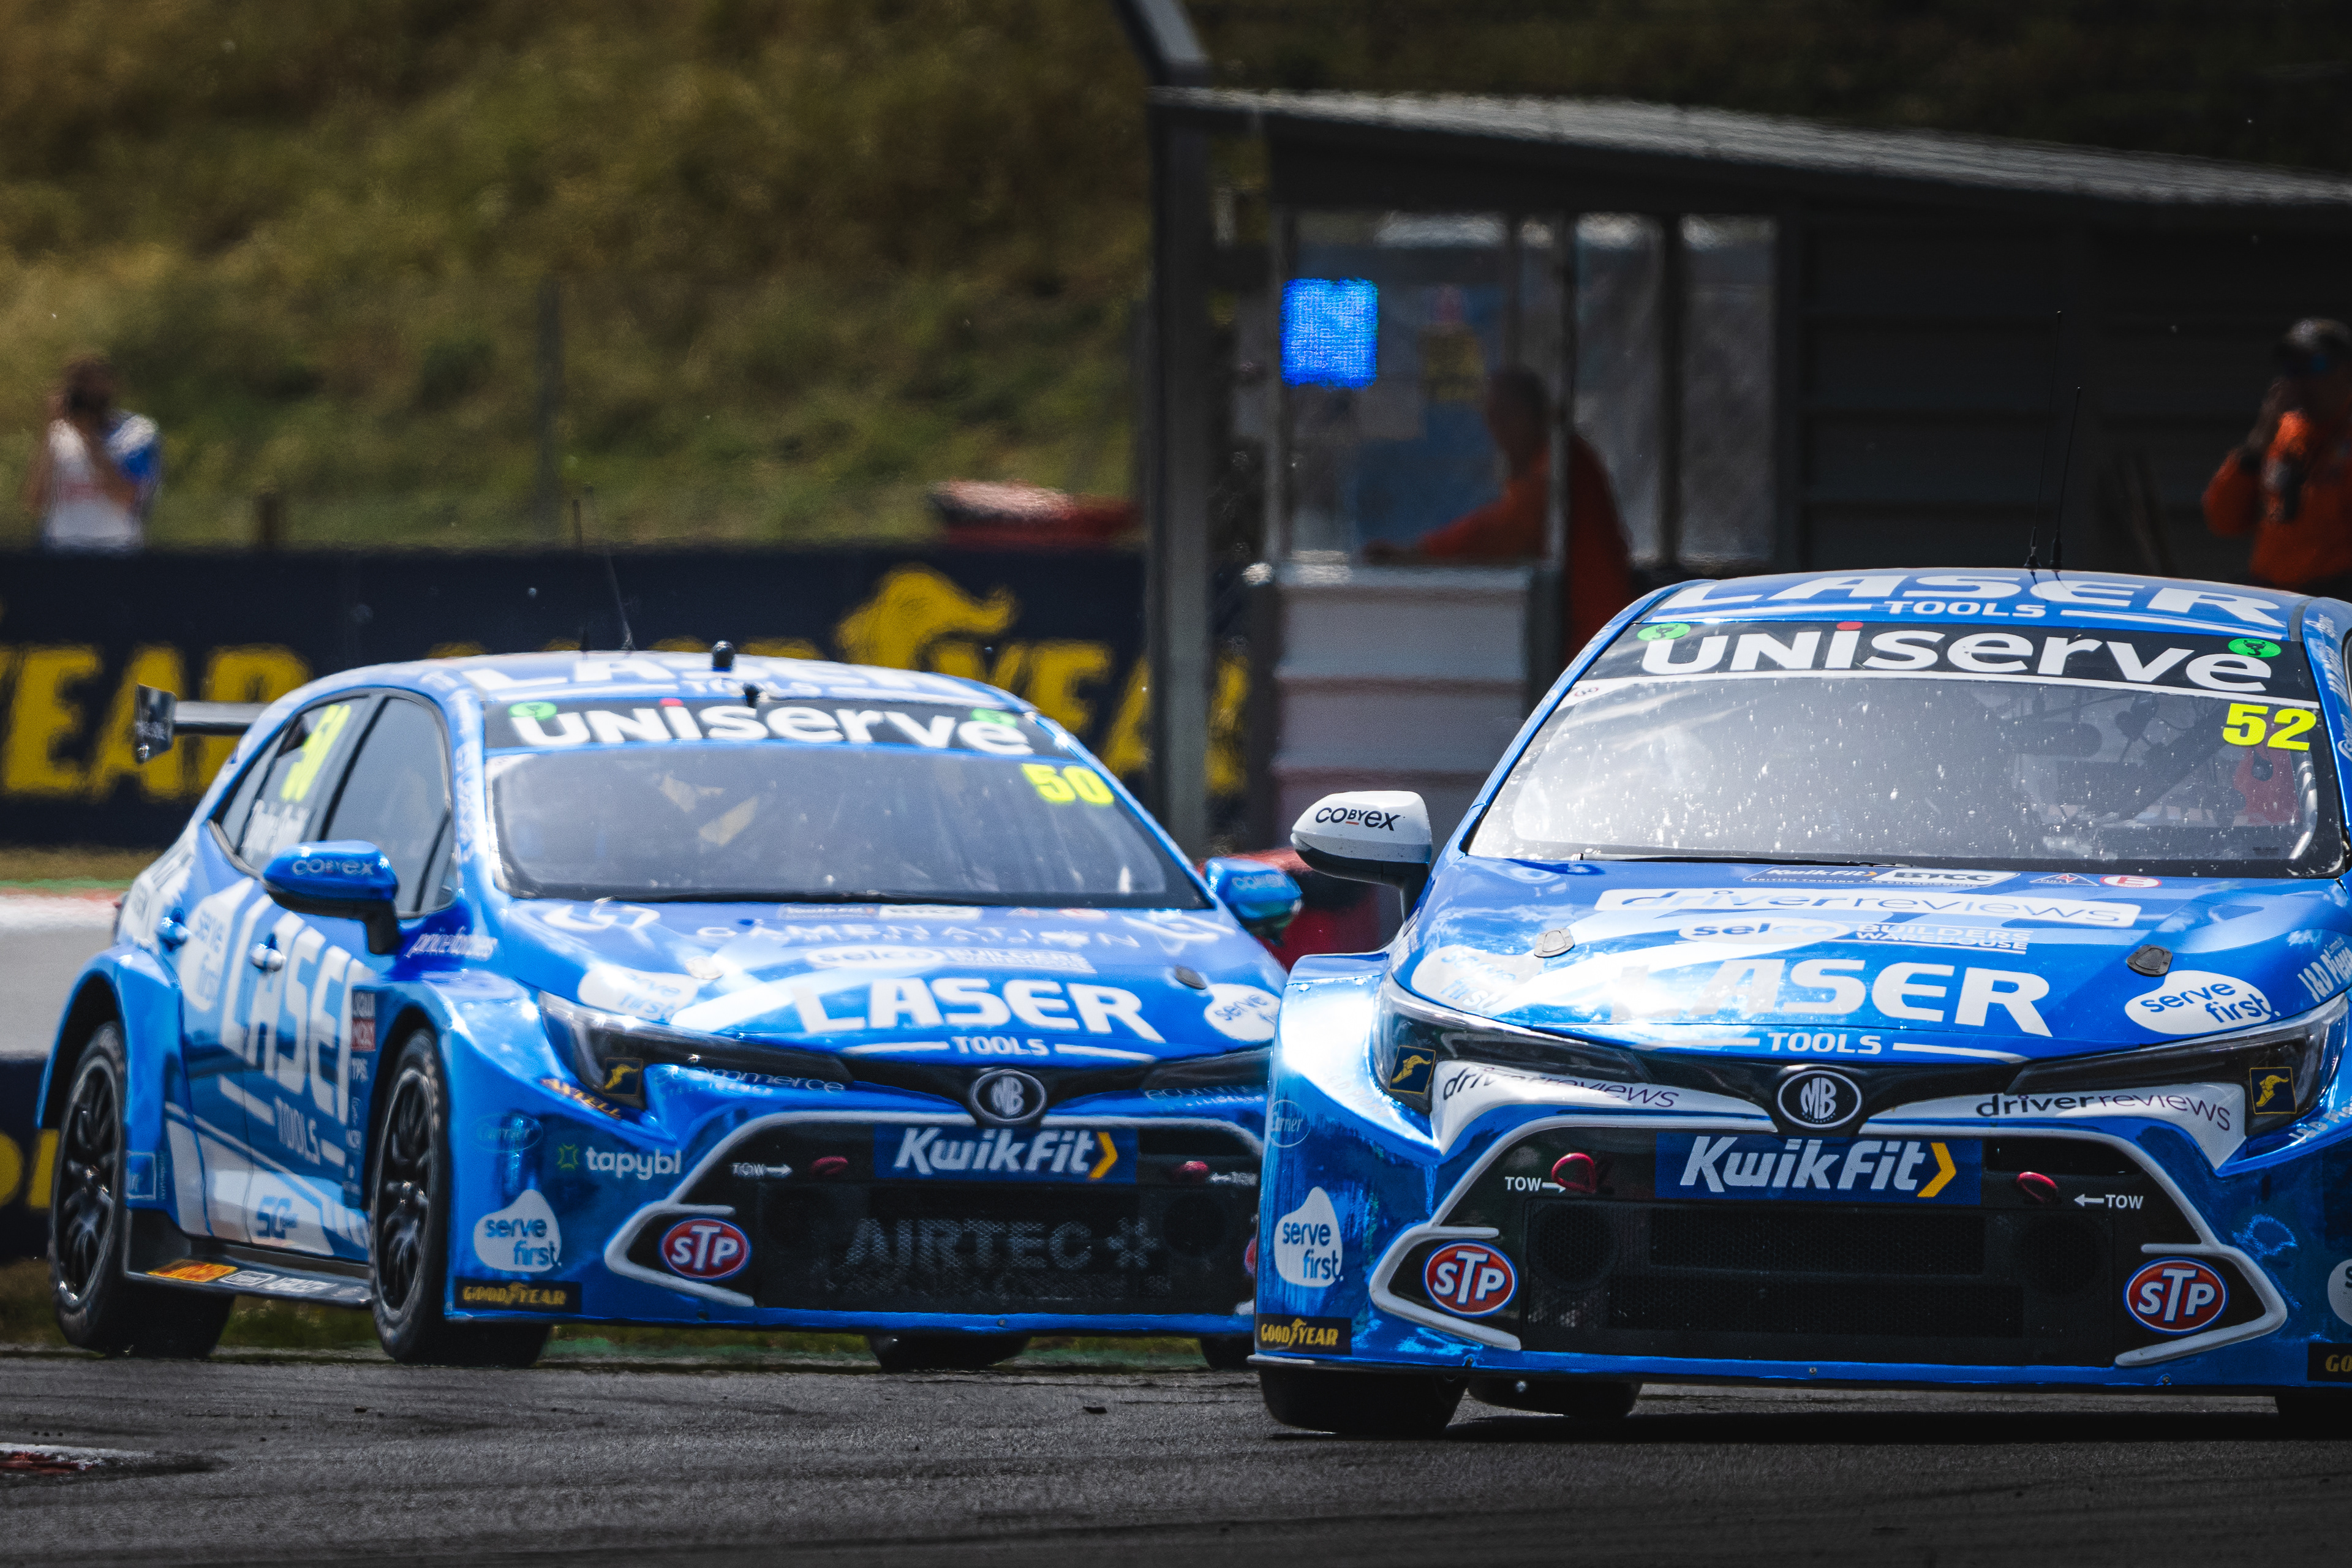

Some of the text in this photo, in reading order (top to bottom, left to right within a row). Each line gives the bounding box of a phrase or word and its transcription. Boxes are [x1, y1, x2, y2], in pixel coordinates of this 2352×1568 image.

[1657, 573, 2290, 628] LASER
[1883, 600, 2046, 618] TOOLS
[0, 643, 312, 801] EAR
[2222, 703, 2316, 751] 52
[1020, 763, 1114, 804] 50
[1894, 872, 1992, 882] BTCC
[1691, 922, 1839, 937] selco
[1856, 932, 2028, 951] WAREHOUSE
[1857, 924, 2031, 941] BUILDERS
[794, 977, 1166, 1044] LASER
[1610, 959, 2053, 1038] LASER
[2140, 983, 2236, 1012] serve
[951, 1035, 1051, 1057] TOOLS
[1766, 1031, 1882, 1055] TOOLS
[1801, 1077, 1836, 1120] MB
[585, 1145, 682, 1181] tapybl
[1504, 1176, 1542, 1192] TOW
[2105, 1194, 2144, 1209] TOW
[484, 1217, 548, 1239] serve
[1282, 1221, 1330, 1246] serve
[671, 1224, 739, 1270] STP
[845, 1218, 1092, 1270] AIRTEC
[1434, 1250, 1506, 1305] STP
[2138, 1268, 2217, 1322] STP
[1260, 1322, 1339, 1347] GOODYEAR
